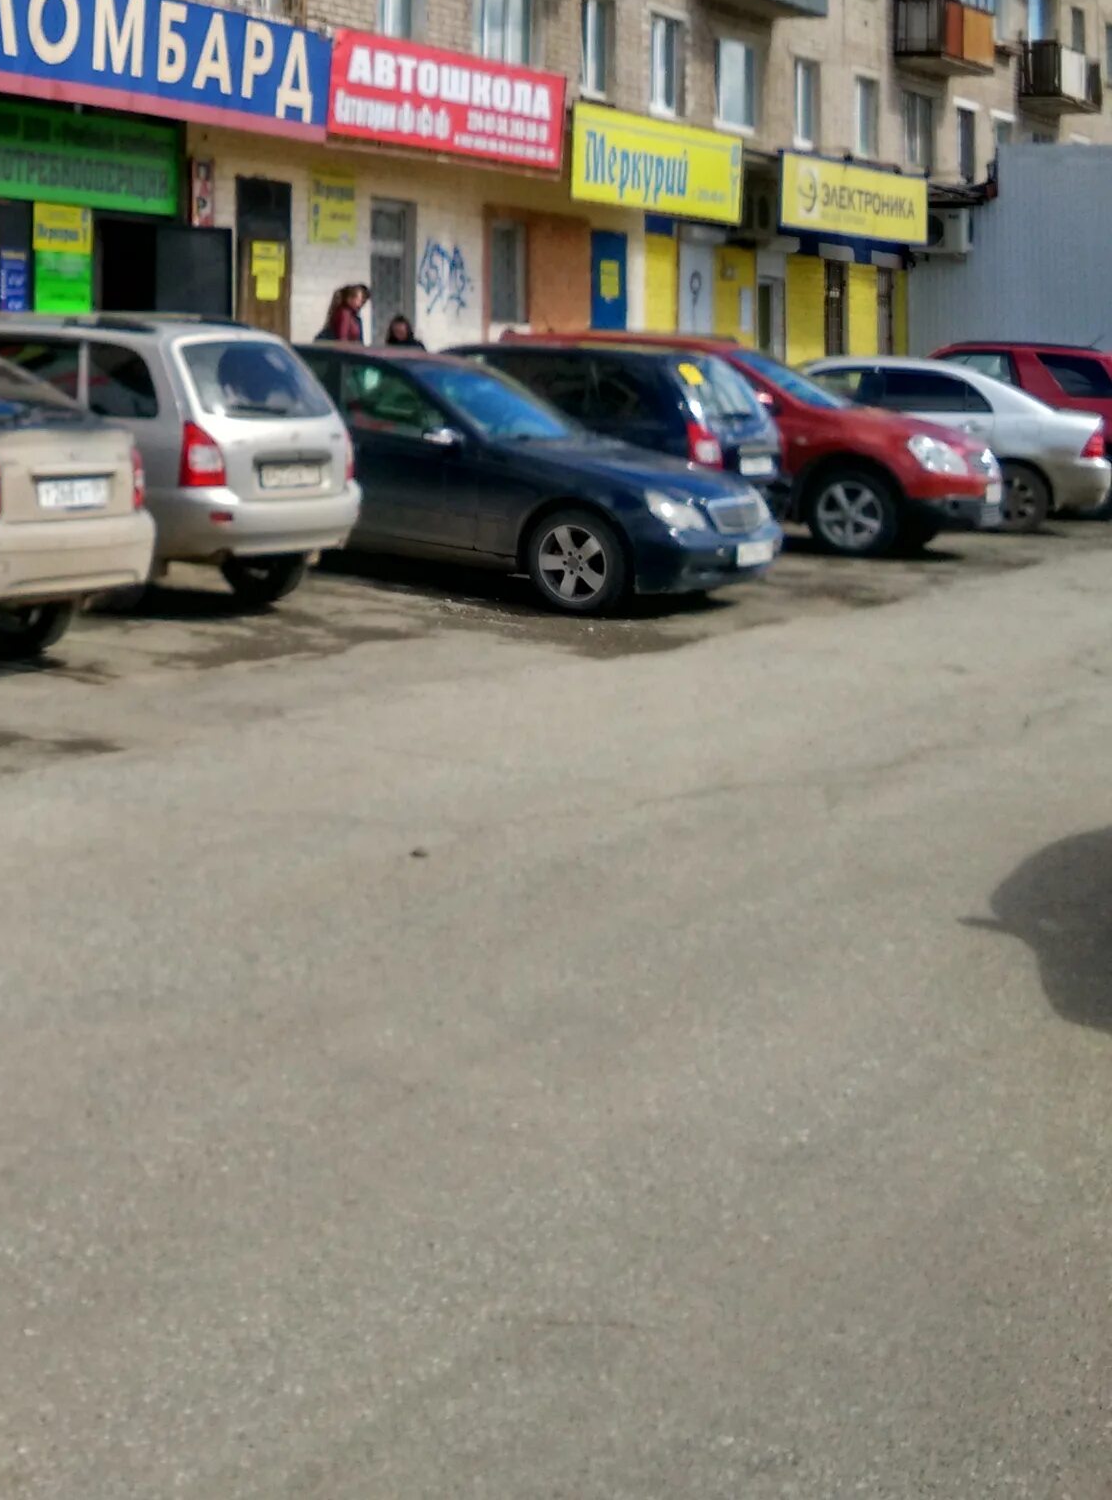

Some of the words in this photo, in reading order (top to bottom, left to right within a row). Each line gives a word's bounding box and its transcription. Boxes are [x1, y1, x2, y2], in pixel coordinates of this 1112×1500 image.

[346, 44, 551, 121] АВТОШКОЛА
[585, 130, 689, 204] Меркурий
[821, 182, 916, 220] ЭЛЕКТРОНИКА
